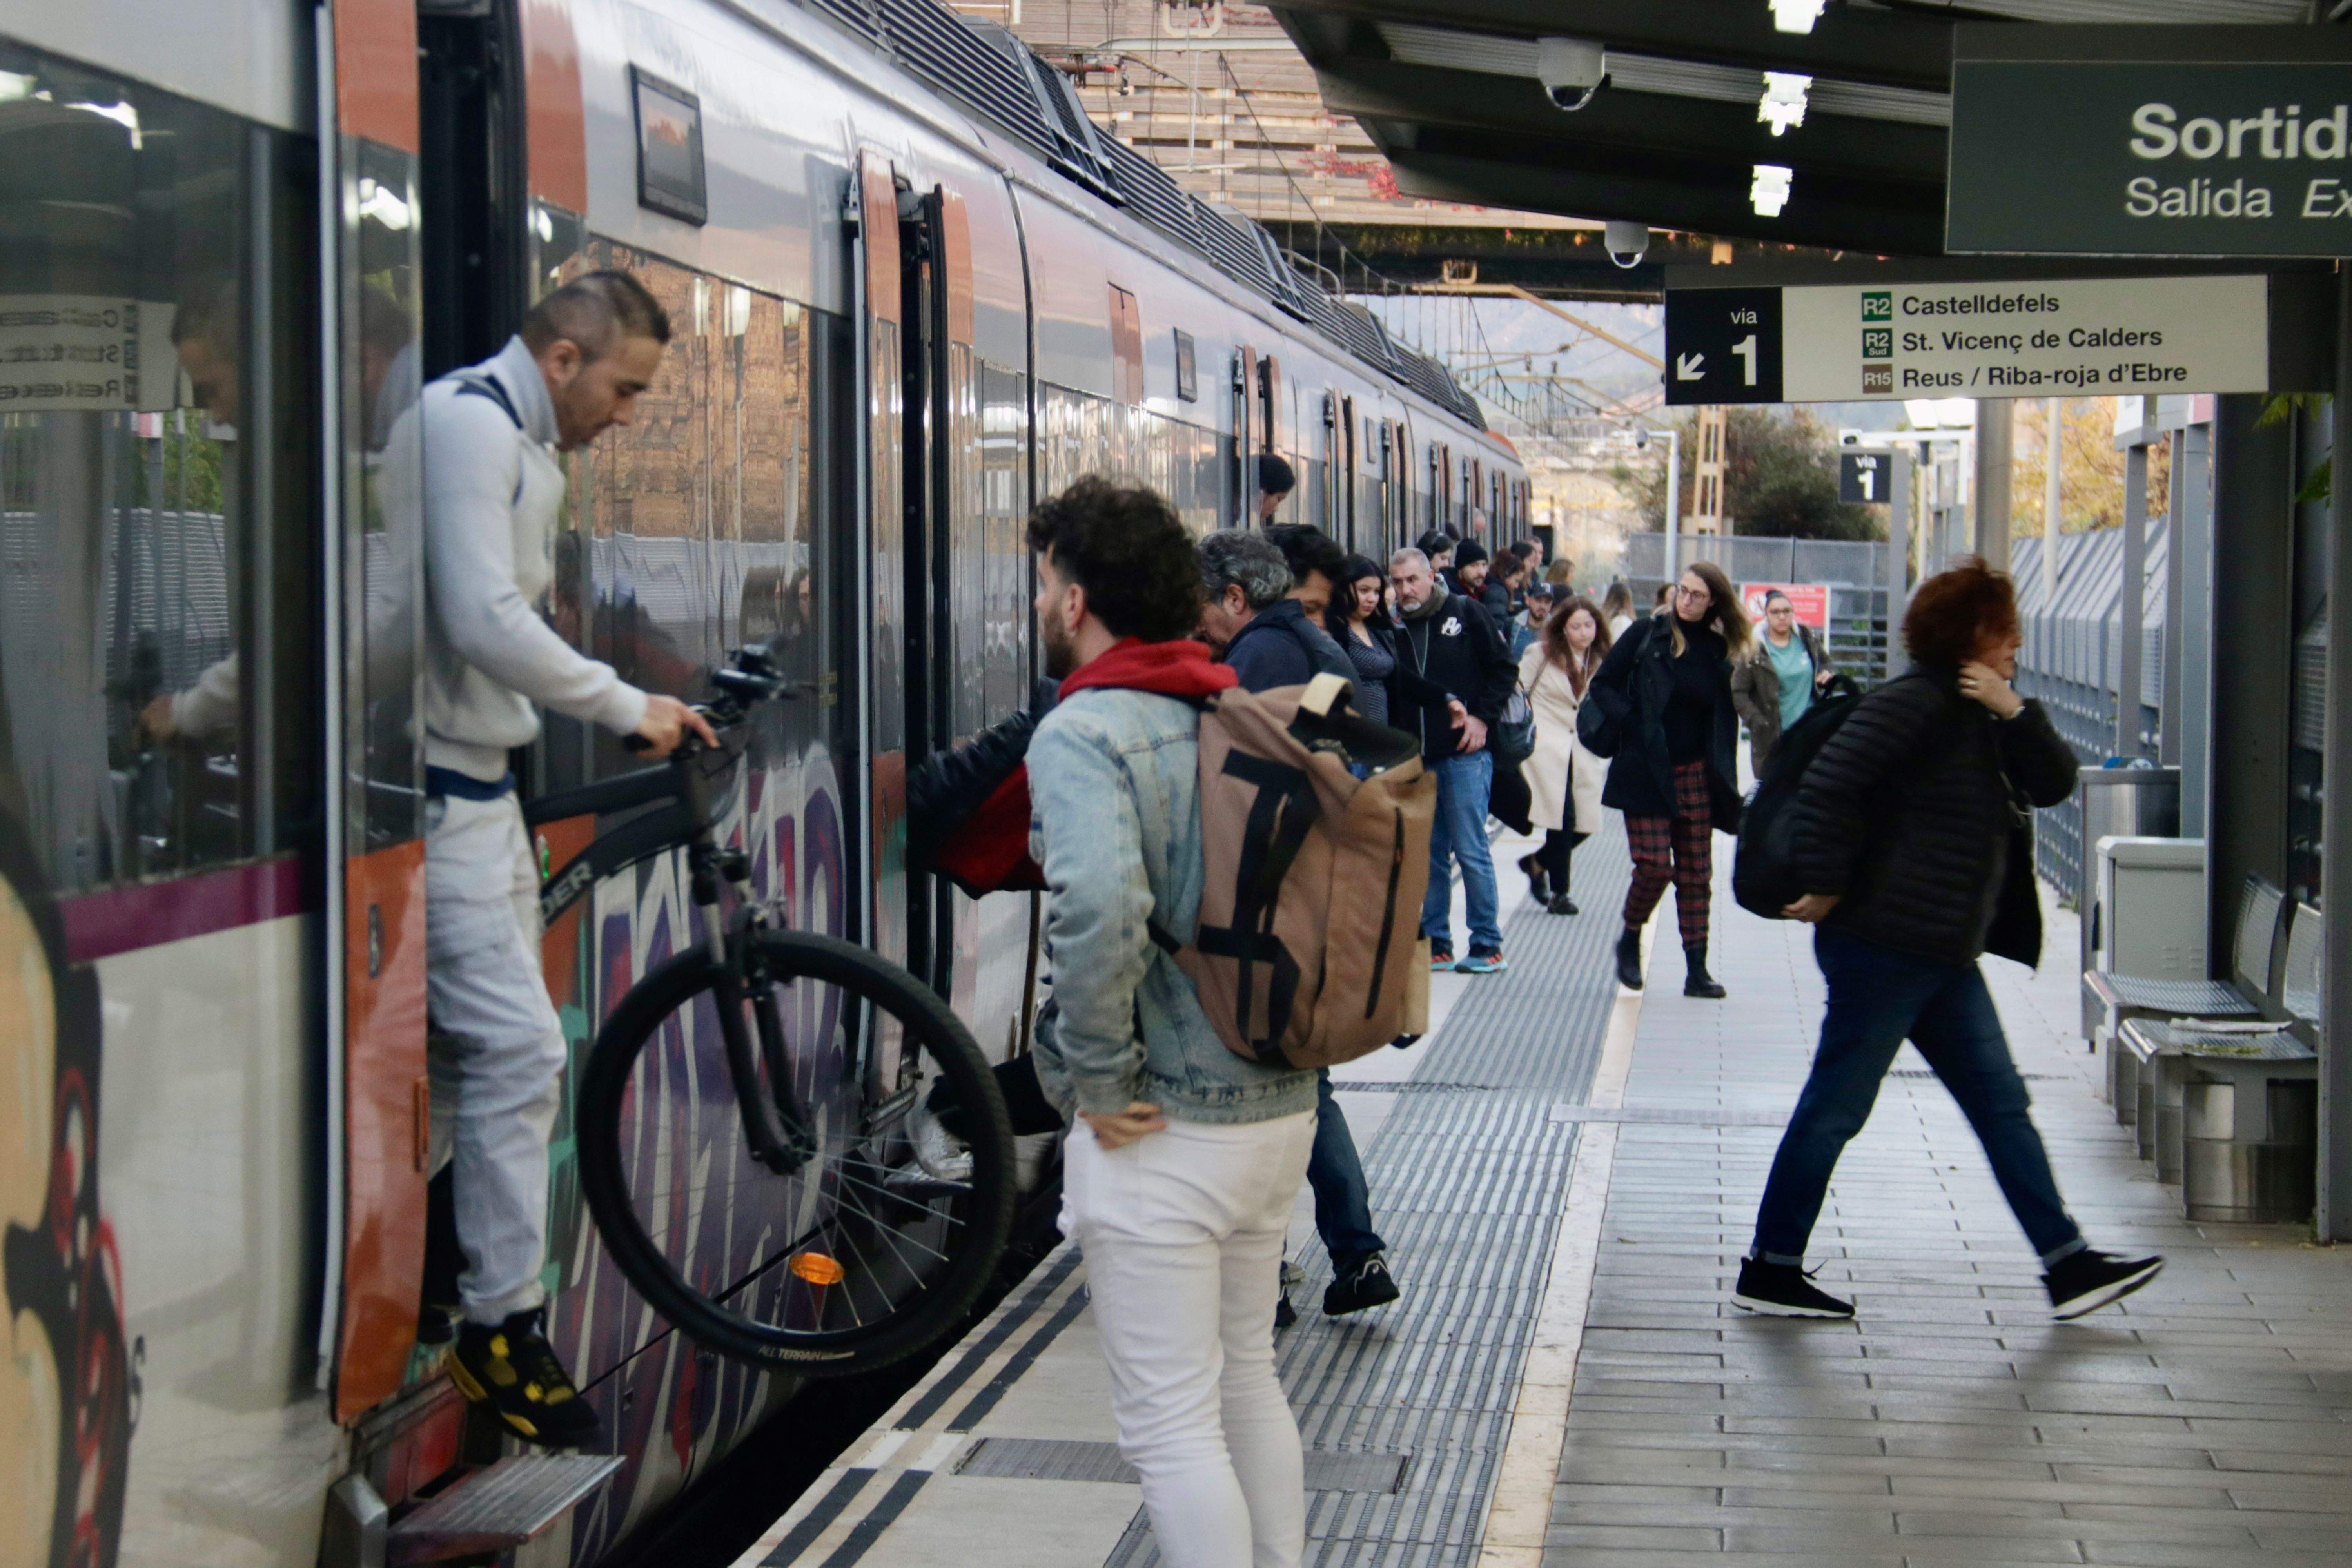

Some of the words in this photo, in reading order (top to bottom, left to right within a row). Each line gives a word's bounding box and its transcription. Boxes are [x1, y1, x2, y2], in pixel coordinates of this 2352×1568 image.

[2130, 103, 2352, 160] Sortid
[2125, 177, 2273, 217] Salida
[1730, 308, 1757, 324] via
[1864, 298, 1891, 315] R2
[1902, 293, 2060, 316] Castelldefels
[1866, 332, 1889, 347] R2
[1903, 332, 1933, 351] St.
[1942, 331, 2022, 354] Vicenç
[2031, 329, 2060, 348] de
[2068, 327, 2163, 348] Calders
[1869, 347, 1887, 356] Sud
[1732, 335, 1757, 386] 1
[1864, 372, 1891, 386] R15
[1903, 369, 1963, 387] Reus
[1971, 367, 1980, 386] /
[1989, 365, 2100, 388] Riba-roja
[1856, 455, 1877, 469] via
[1858, 470, 1874, 501] 1
[758, 1345, 777, 1357] ALL
[779, 1348, 821, 1361] TERRAIN
